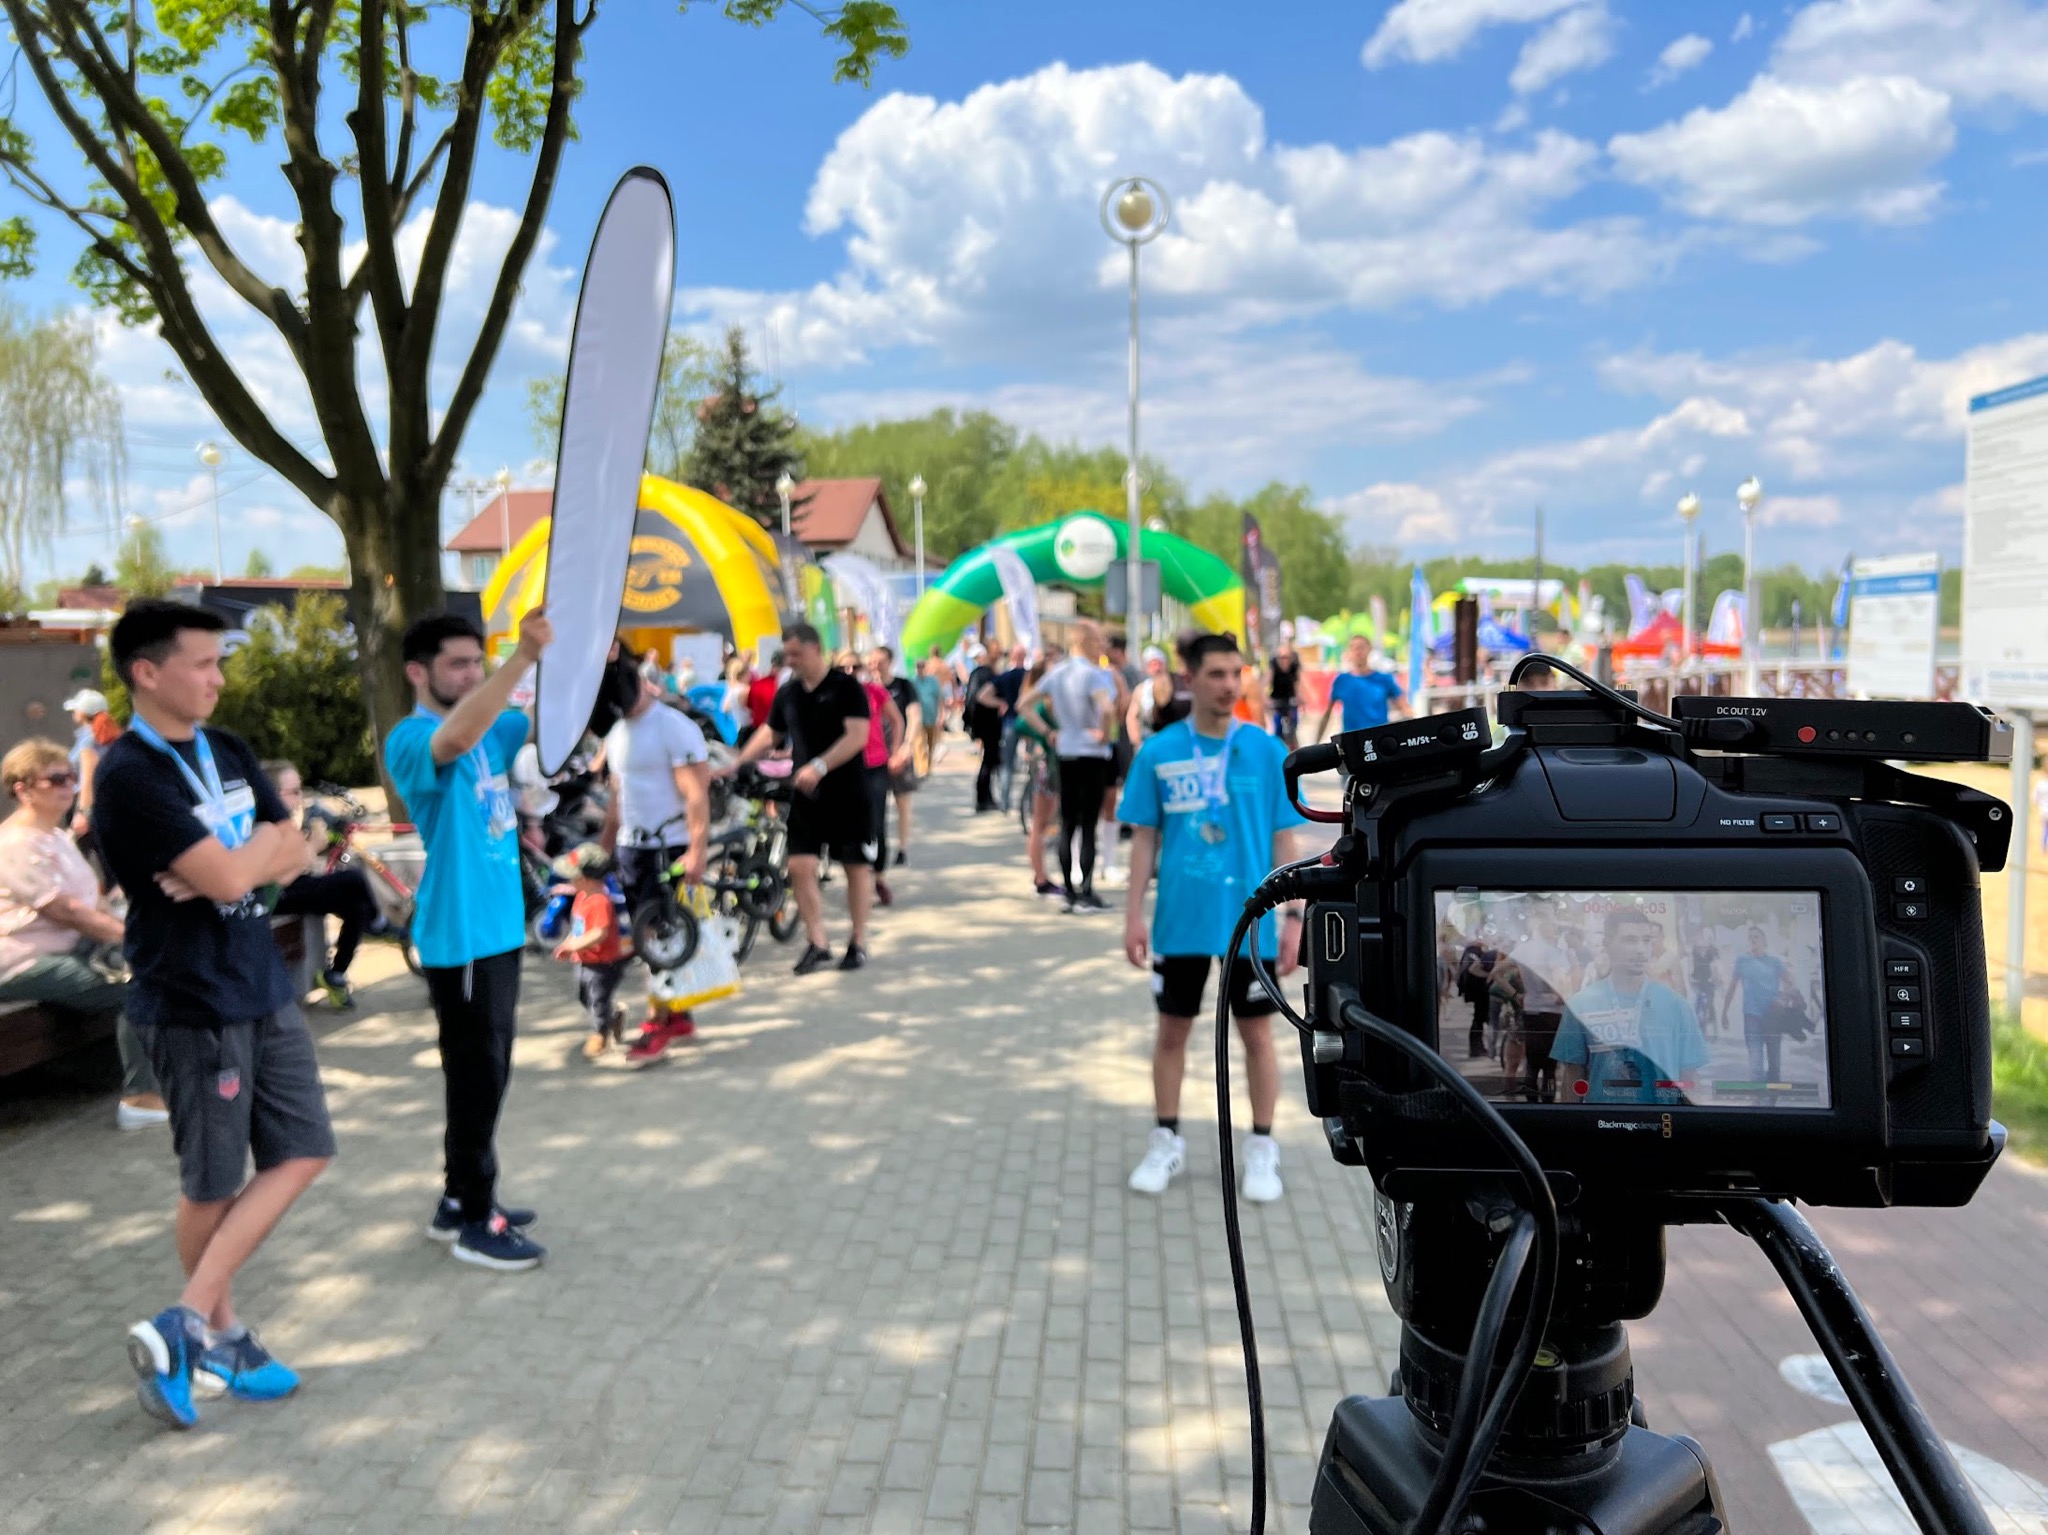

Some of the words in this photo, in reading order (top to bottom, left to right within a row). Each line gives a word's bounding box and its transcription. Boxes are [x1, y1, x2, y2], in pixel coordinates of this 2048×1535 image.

[1716, 706, 1729, 715] DC
[1730, 707, 1749, 715] OUT
[1750, 707, 1767, 716] 12V
[1461, 721, 1477, 732] 1/2
[1364, 752, 1378, 762] dB
[1719, 818, 1731, 826] ND
[1732, 818, 1755, 826] FILTER
[1487, 1258, 1494, 1268] 2
[1586, 1259, 1593, 1269] 2
[1584, 1282, 1592, 1292] 3
